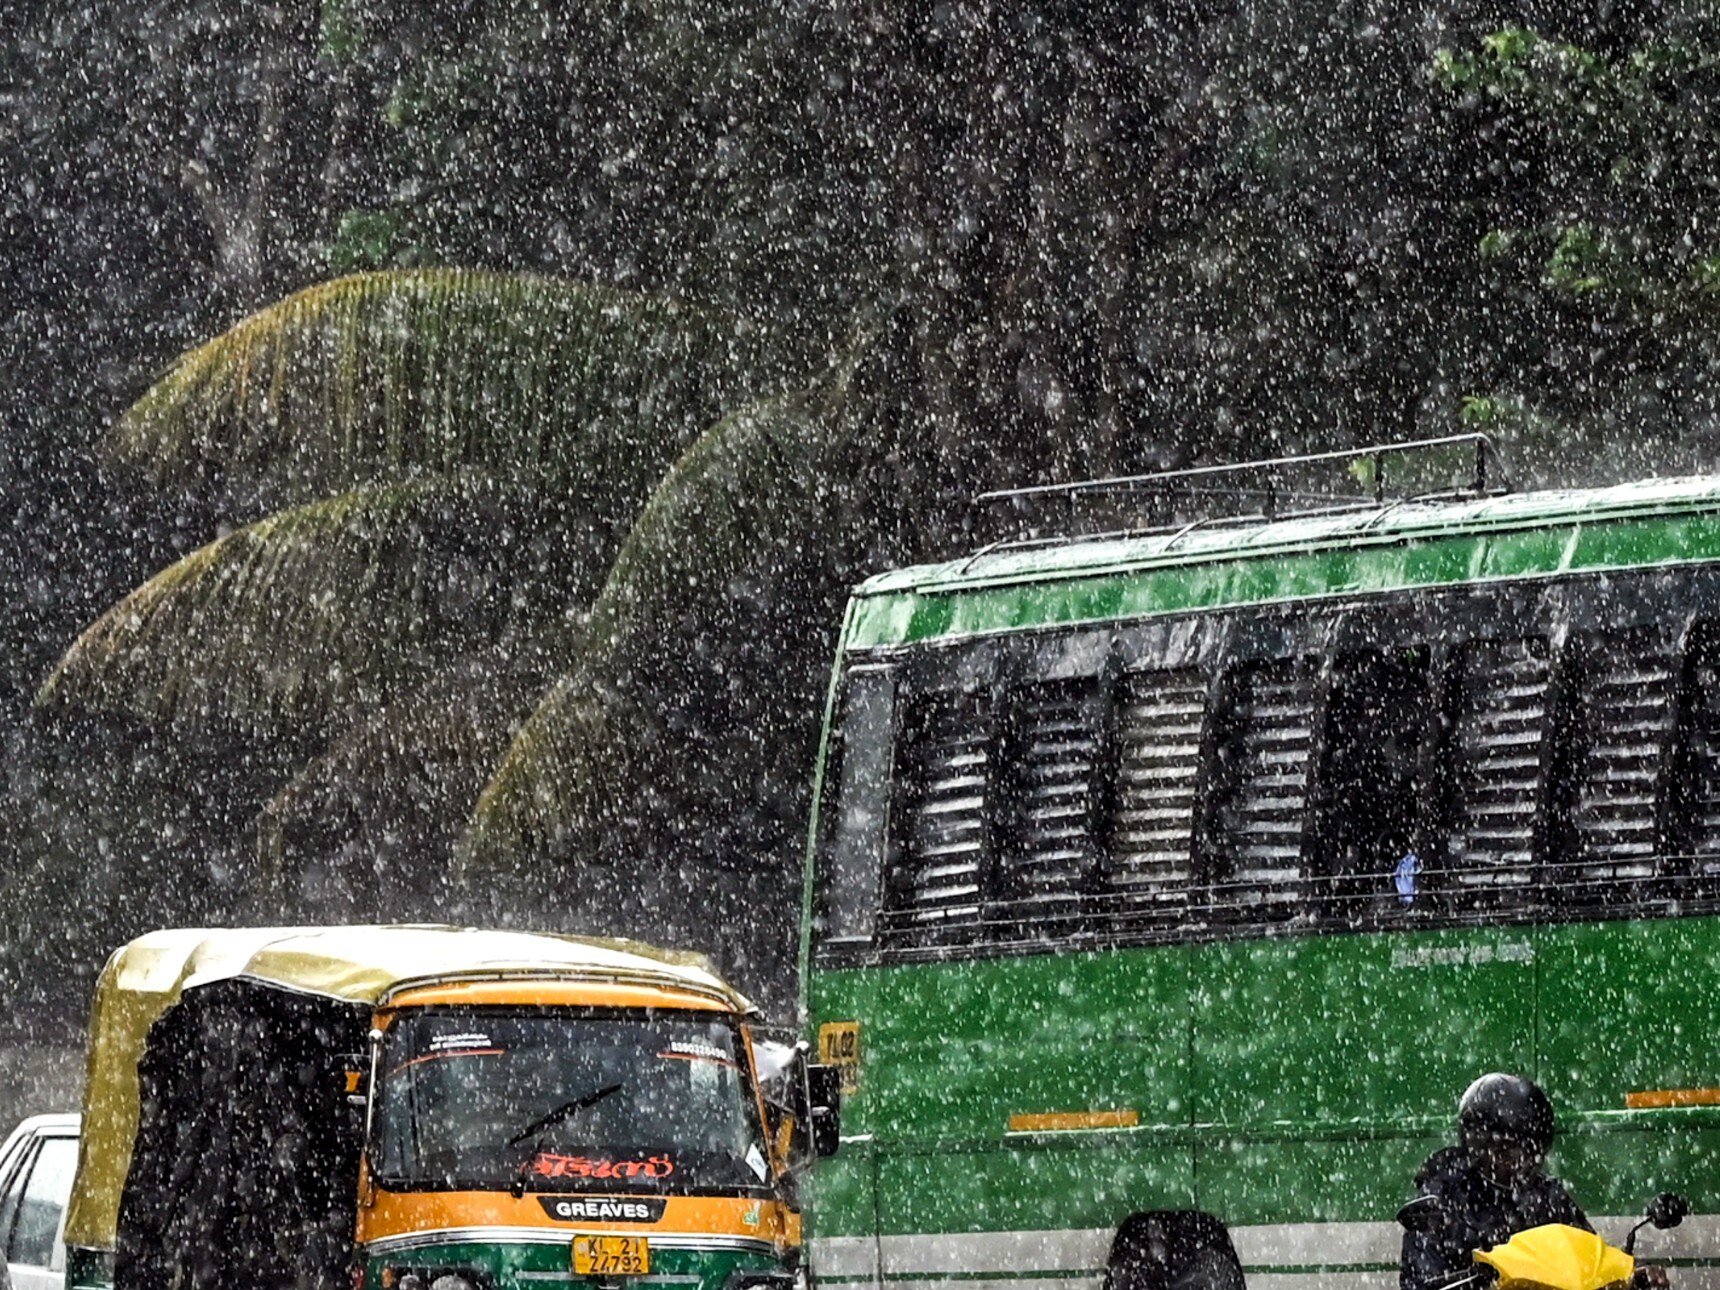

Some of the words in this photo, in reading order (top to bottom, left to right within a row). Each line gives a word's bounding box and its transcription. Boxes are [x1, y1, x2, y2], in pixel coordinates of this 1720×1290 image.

[556, 1202, 650, 1219] GREAVES
[588, 1238, 609, 1255] KL
[621, 1238, 639, 1255] 21
